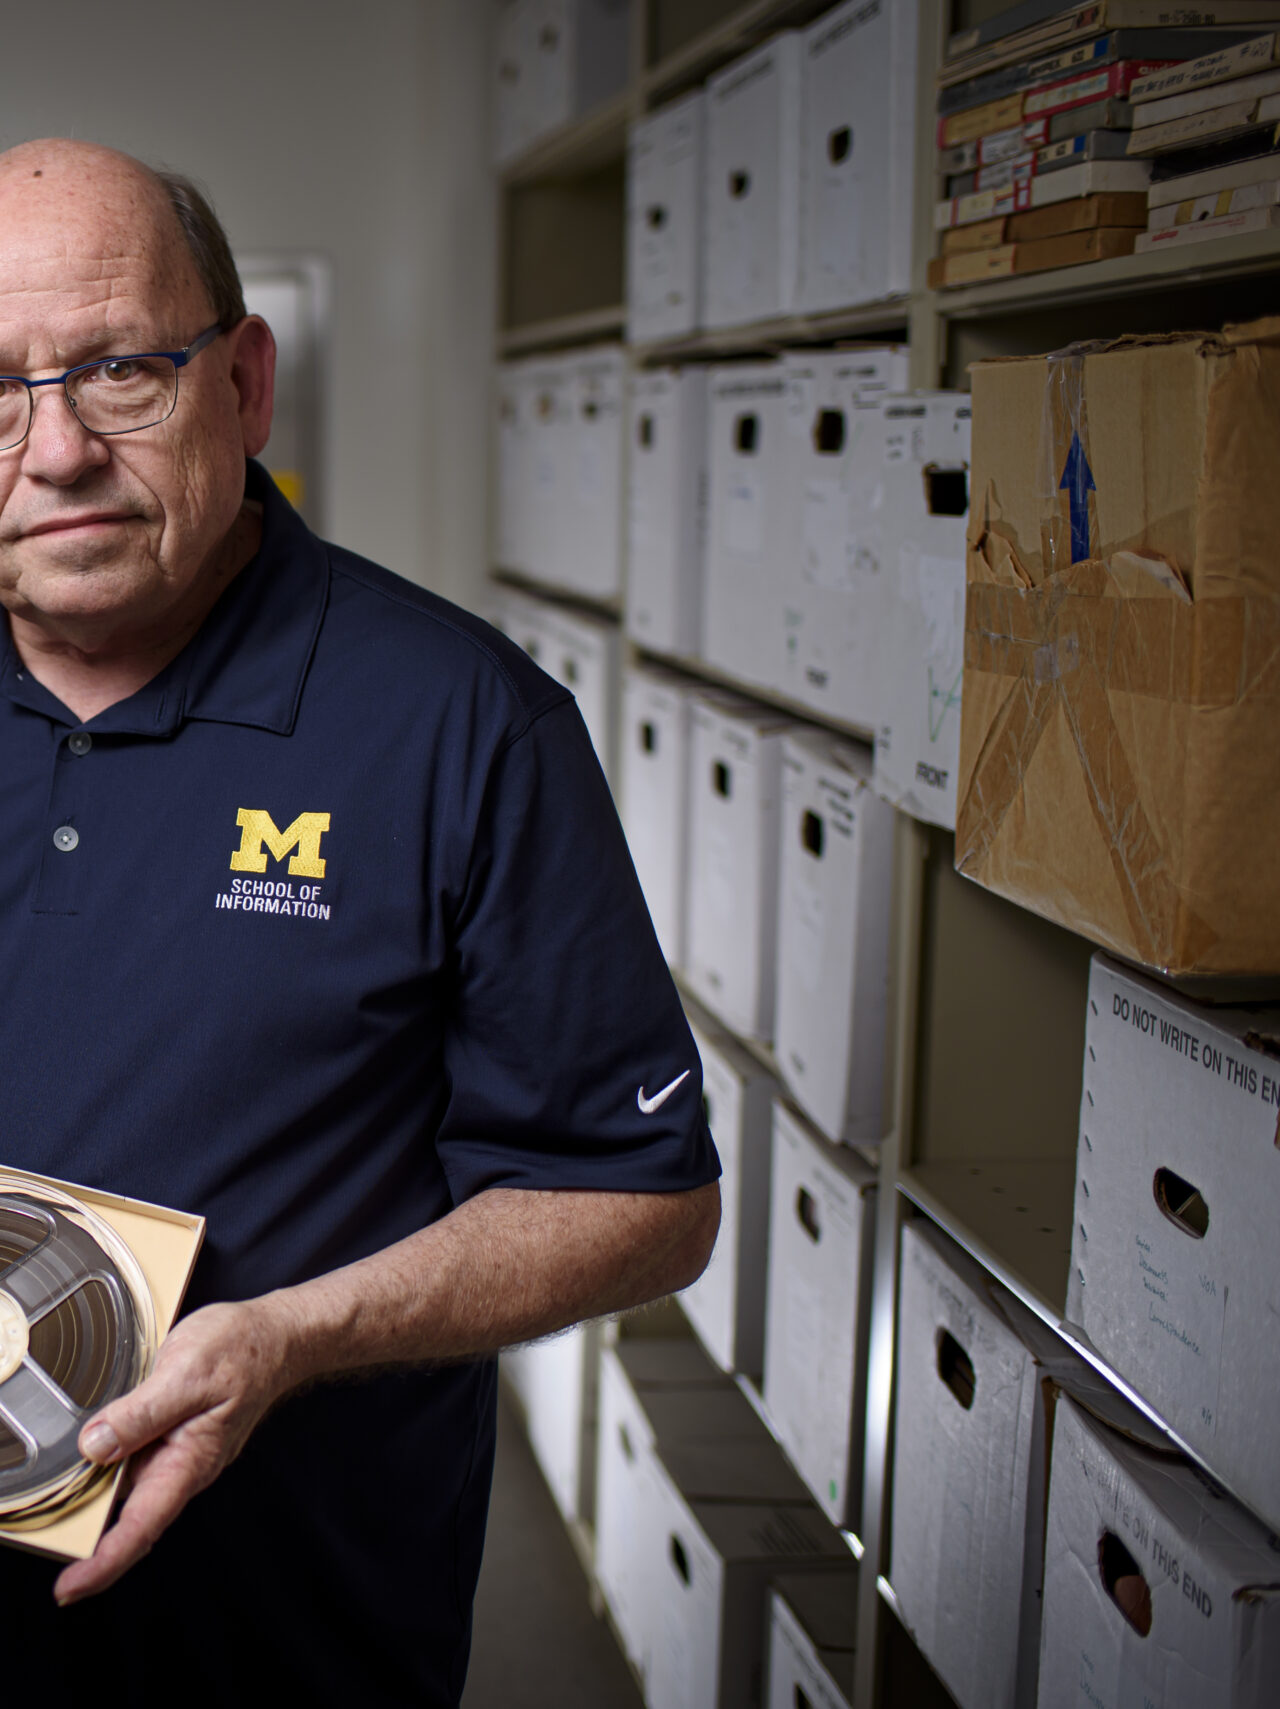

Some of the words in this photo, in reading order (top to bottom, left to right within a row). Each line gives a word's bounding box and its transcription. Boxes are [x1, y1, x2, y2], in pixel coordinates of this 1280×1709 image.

[230, 808, 331, 878] M
[215, 893, 331, 920] INFORMATION
[231, 878, 295, 899] SCHOOL
[299, 885, 322, 901] OF
[1113, 994, 1130, 1021] DO
[1132, 1005, 1158, 1037] NOT
[1160, 1019, 1199, 1062] WRITE
[1202, 1044, 1222, 1075] ON
[1226, 1056, 1257, 1094] THIS
[1131, 1518, 1149, 1550] ON
[1152, 1539, 1180, 1585] THIS
[1182, 1572, 1213, 1619] END
